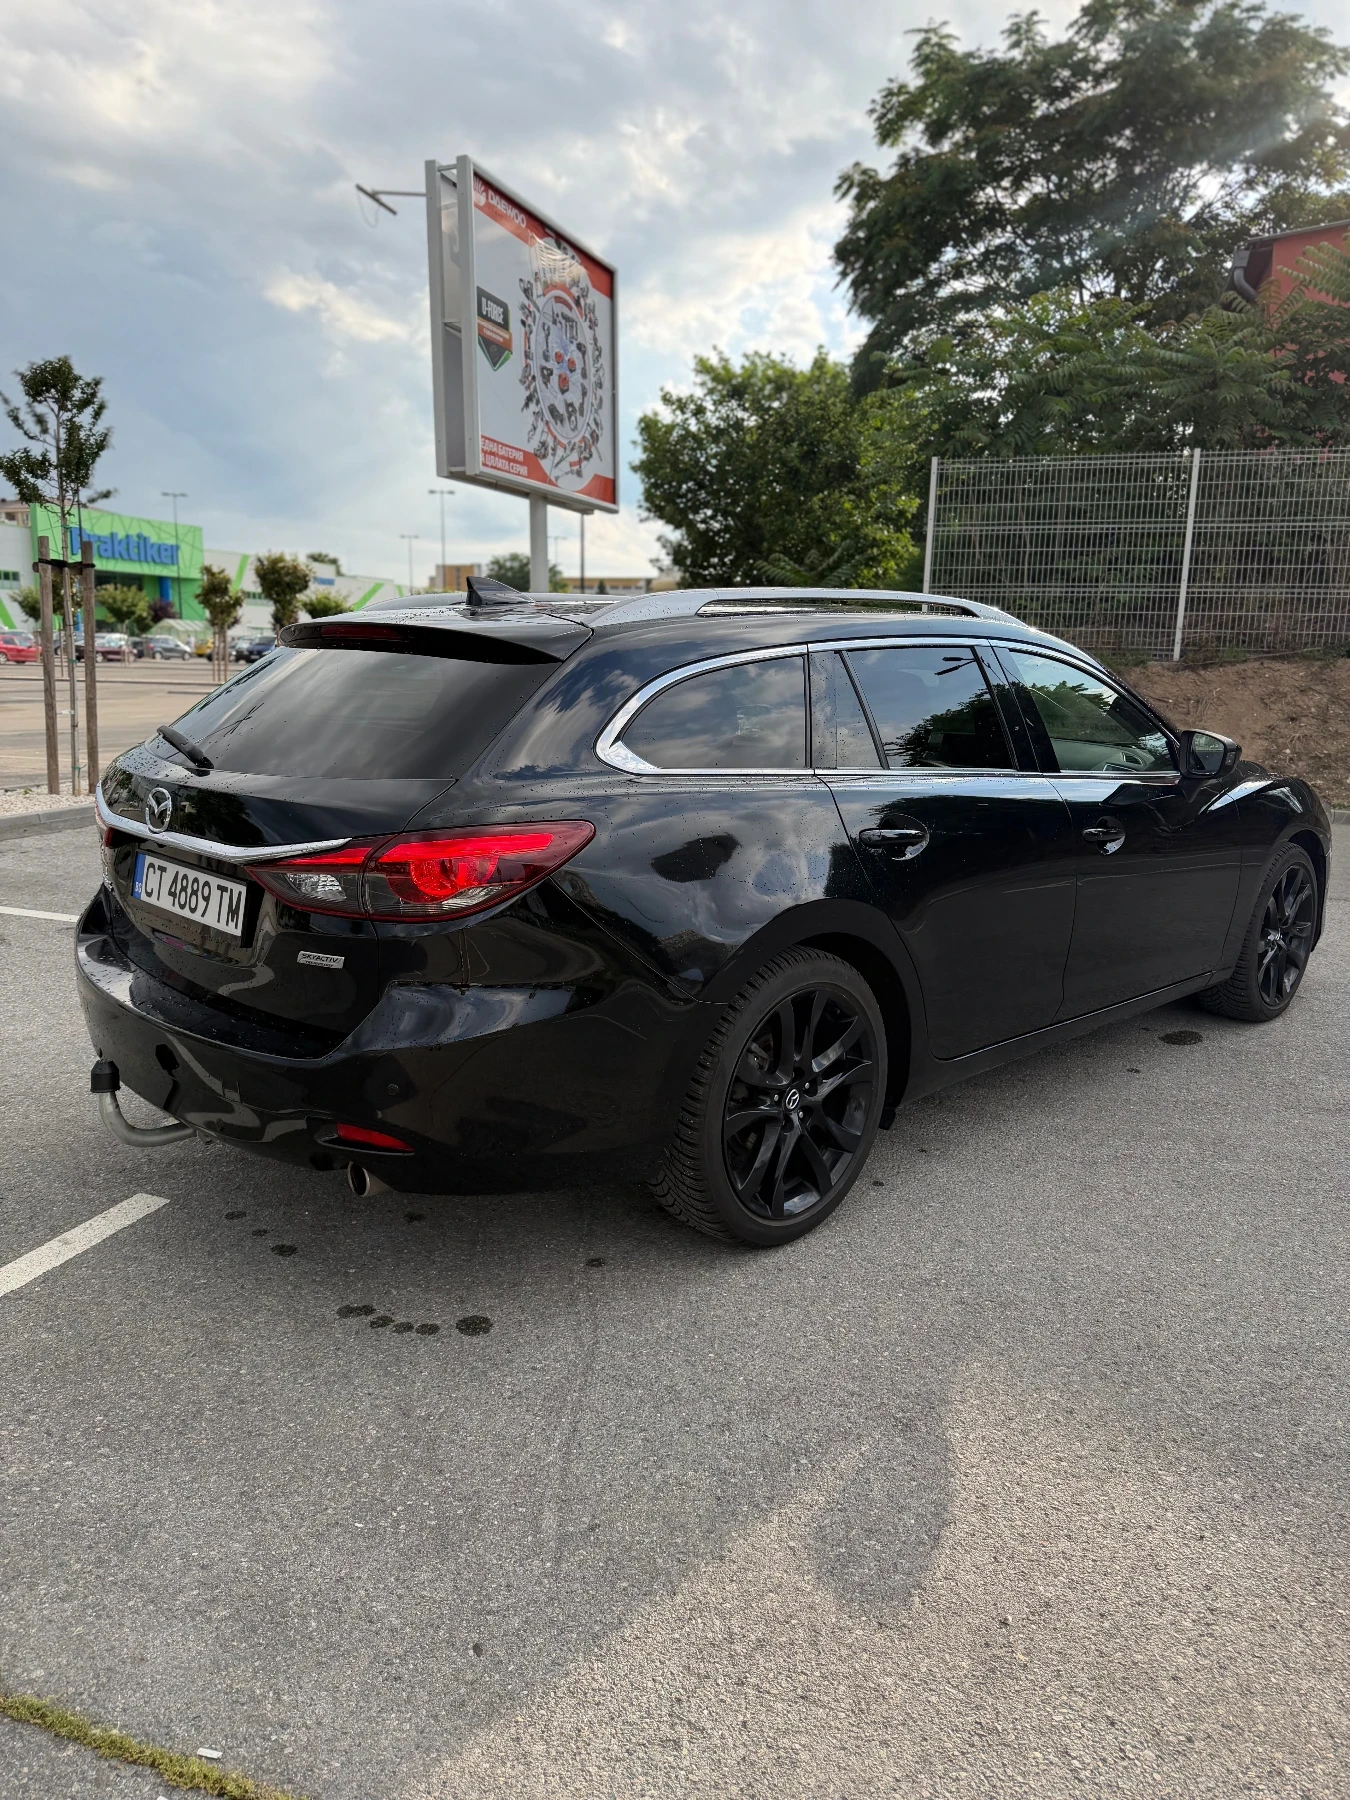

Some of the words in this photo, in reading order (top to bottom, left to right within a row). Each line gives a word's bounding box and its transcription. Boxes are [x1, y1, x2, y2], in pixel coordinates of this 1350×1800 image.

[488, 189, 526, 228] DAEWOO
[481, 296, 504, 324] U-FORCE
[485, 453, 509, 471] ЦЯЛАТА
[510, 462, 528, 477] СЕРИЯ
[498, 444, 523, 462] БАТЕРИЯ
[70, 526, 179, 565] Praktiker
[144, 863, 167, 901] CT
[167, 870, 212, 918] 4889
[216, 884, 243, 930] TM
[302, 953, 338, 963] SKYACTIV
